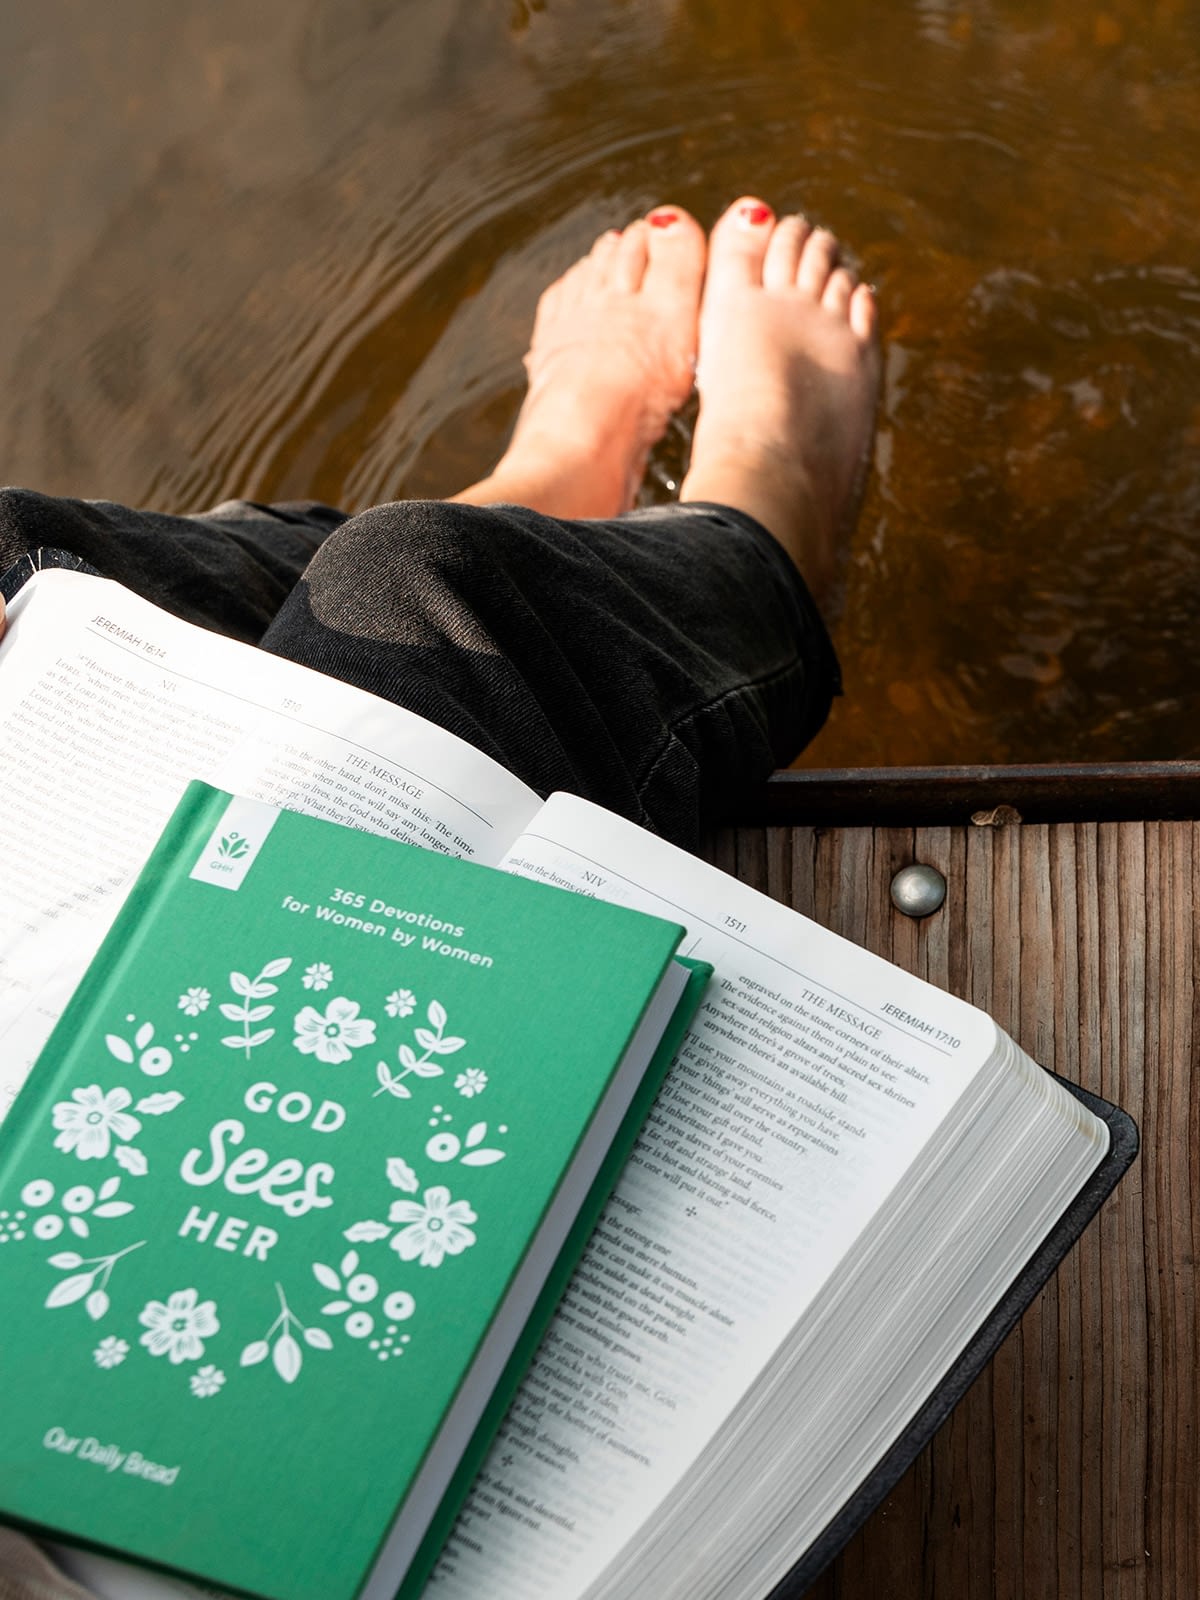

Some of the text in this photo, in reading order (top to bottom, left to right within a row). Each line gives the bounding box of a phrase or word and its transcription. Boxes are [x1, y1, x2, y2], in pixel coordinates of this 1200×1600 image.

[90, 615, 142, 645] JEREMIAH
[345, 752, 423, 799] THE MESSAGE
[309, 783, 334, 801] lives,
[332, 793, 348, 808] the
[348, 802, 370, 819] God
[369, 815, 391, 830] who
[311, 771, 334, 786] when
[334, 782, 348, 792] no
[348, 789, 366, 802] one
[367, 798, 385, 811] will
[381, 808, 400, 825] say
[398, 818, 420, 837] any
[419, 827, 452, 855] longer,
[337, 766, 362, 785] hand,
[363, 780, 387, 797] don't
[387, 794, 409, 810] miss
[410, 807, 432, 824] this:
[434, 819, 454, 838] The
[452, 833, 475, 855] time
[521, 861, 535, 871] on
[534, 865, 550, 878] the
[548, 871, 576, 890] horns
[580, 870, 606, 886] NIV
[283, 896, 492, 967] for Women by Women
[330, 889, 464, 936] 365 Devotions
[723, 915, 747, 933] 1511
[699, 999, 748, 1031] Anywhere
[776, 1044, 784, 1052] a
[782, 1048, 811, 1066] grove
[810, 1062, 824, 1073] of
[719, 977, 738, 994] The
[736, 990, 777, 1015] evidence
[776, 1012, 810, 1034] against
[809, 1029, 834, 1048] them
[834, 1043, 844, 1053] is
[842, 1049, 868, 1067] plain
[868, 1062, 880, 1073] to
[738, 975, 781, 1001] engraved
[778, 997, 793, 1009] on
[792, 1003, 810, 1017] the
[809, 1013, 835, 1031] stone
[834, 1028, 869, 1051] corners
[869, 1047, 882, 1057] of
[880, 1053, 904, 1069] their
[800, 988, 882, 1039] THE MESSAGE
[880, 1002, 961, 1048] JEREMIAH 17:10
[701, 1017, 748, 1047] anywhere
[775, 1059, 789, 1071] an
[789, 1067, 830, 1093] available
[719, 994, 916, 1108] sex-and-religion altars and sacred sex shrines
[244, 1082, 346, 1132] GOD
[670, 1089, 692, 1107] lose
[689, 1102, 713, 1120] your
[711, 1115, 730, 1128] gift
[729, 1124, 743, 1134] of
[675, 1062, 700, 1081] your
[733, 1092, 753, 1107] will
[750, 1103, 776, 1120] serve
[775, 1117, 787, 1126] as
[786, 1123, 839, 1156] reparations
[677, 1079, 702, 1096] your
[700, 1092, 720, 1107] sins
[719, 1102, 734, 1114] all
[732, 1109, 754, 1124] over
[753, 1119, 771, 1133] the
[680, 1045, 699, 1061] for
[694, 1056, 726, 1079] giving
[723, 1072, 749, 1090] away
[748, 1085, 798, 1118] everything
[796, 1112, 817, 1127] you
[697, 1040, 715, 1055] use
[712, 1050, 737, 1069] your
[736, 1059, 785, 1092] mountains
[784, 1089, 796, 1099] as
[796, 1095, 836, 1121] roadside
[836, 1118, 866, 1138] stands
[665, 1103, 716, 1137] inheritance
[719, 1136, 744, 1152] gave
[180, 1119, 334, 1217] Sees
[179, 1208, 278, 1261] HER
[44, 1428, 179, 1484] Our Daily Bread
